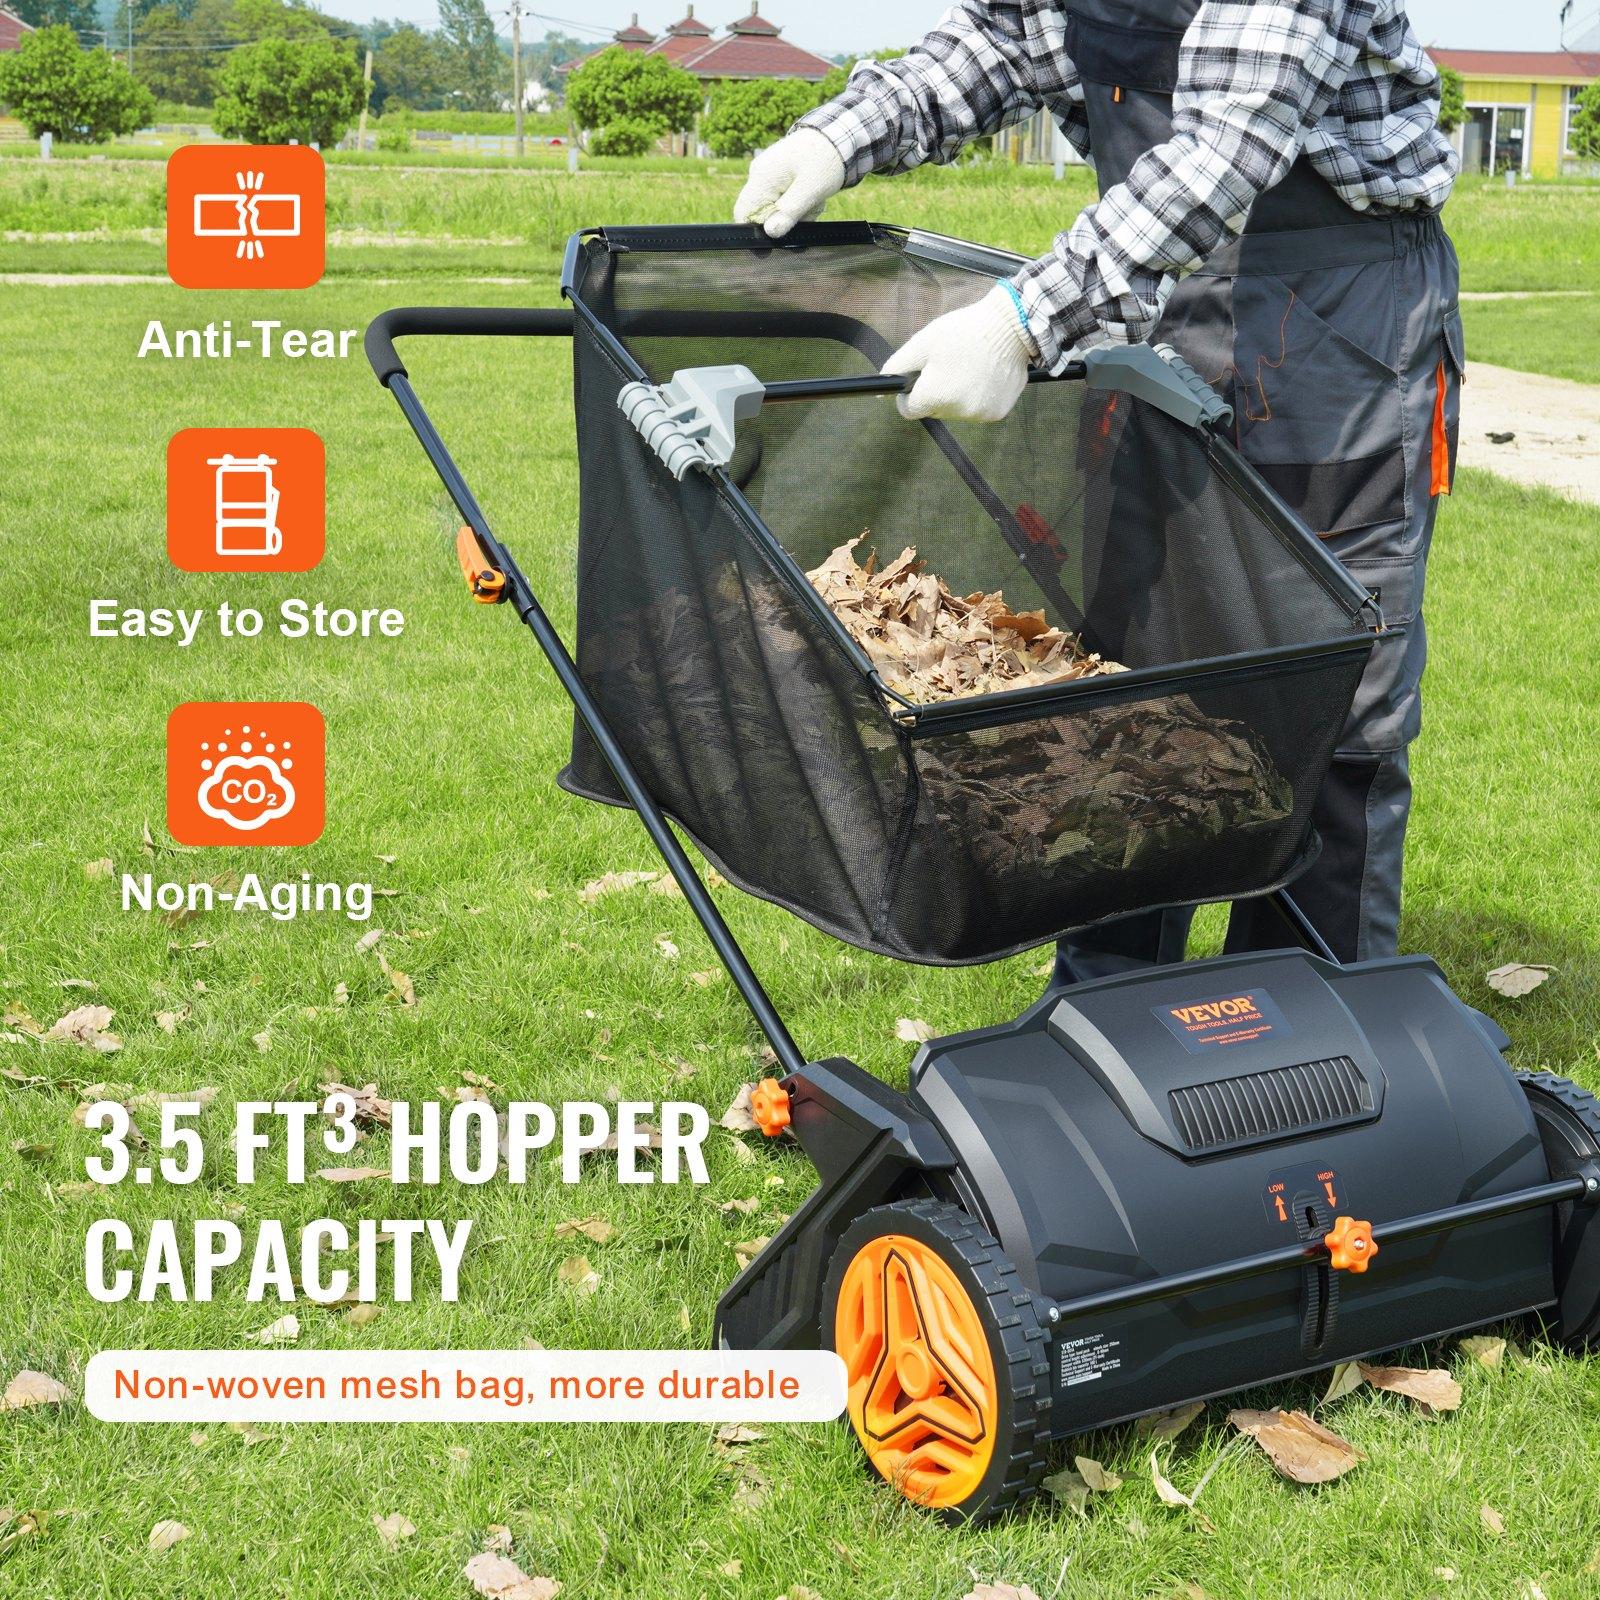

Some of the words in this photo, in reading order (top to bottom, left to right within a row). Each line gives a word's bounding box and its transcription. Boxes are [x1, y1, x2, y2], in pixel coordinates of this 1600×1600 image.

[1171, 997, 1257, 1024] VEVOR
[1186, 1023, 1207, 1032] TOUGH
[1244, 1013, 1263, 1021] PRICE
[1317, 1171, 1335, 1181] HIGH
[1268, 1183, 1285, 1193] LOW
